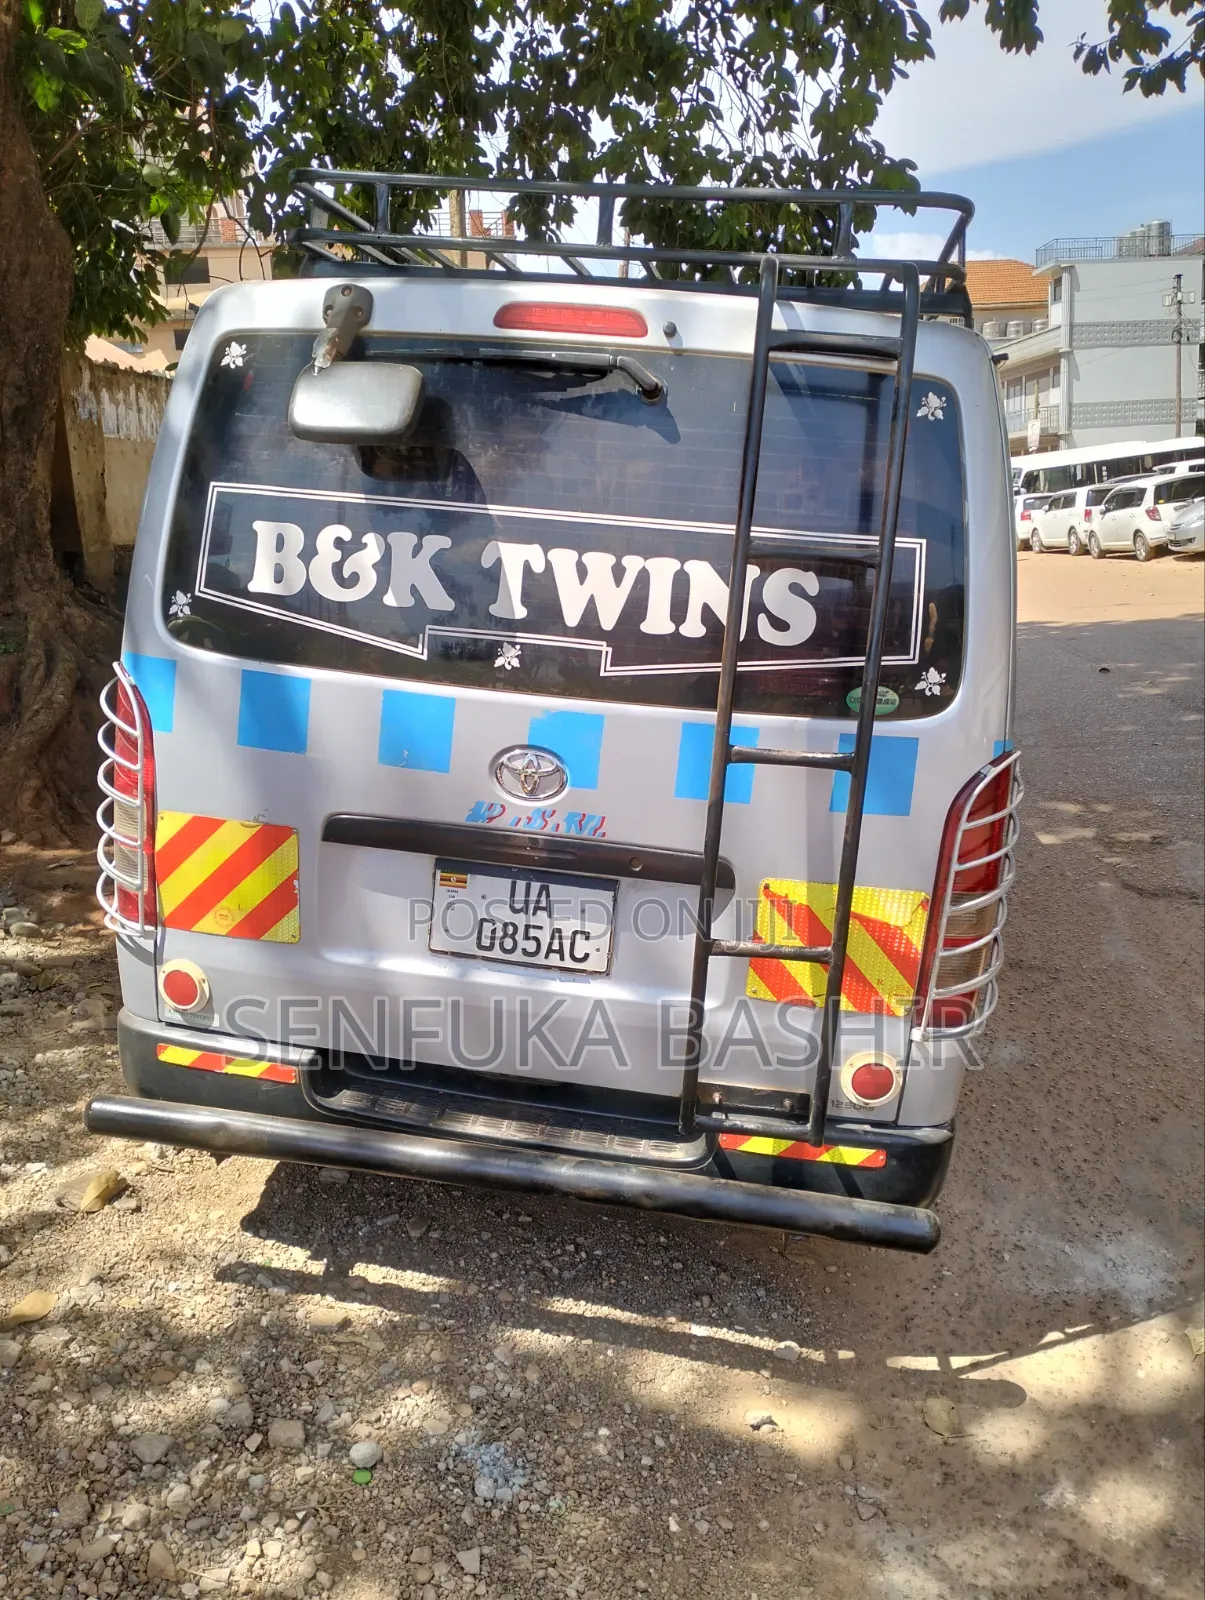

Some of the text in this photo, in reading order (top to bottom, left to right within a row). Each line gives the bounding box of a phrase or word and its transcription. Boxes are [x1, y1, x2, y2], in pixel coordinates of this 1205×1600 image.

[248, 519, 820, 647] B&K TWINS
[508, 879, 553, 919] UA
[475, 917, 591, 963] 085AC
